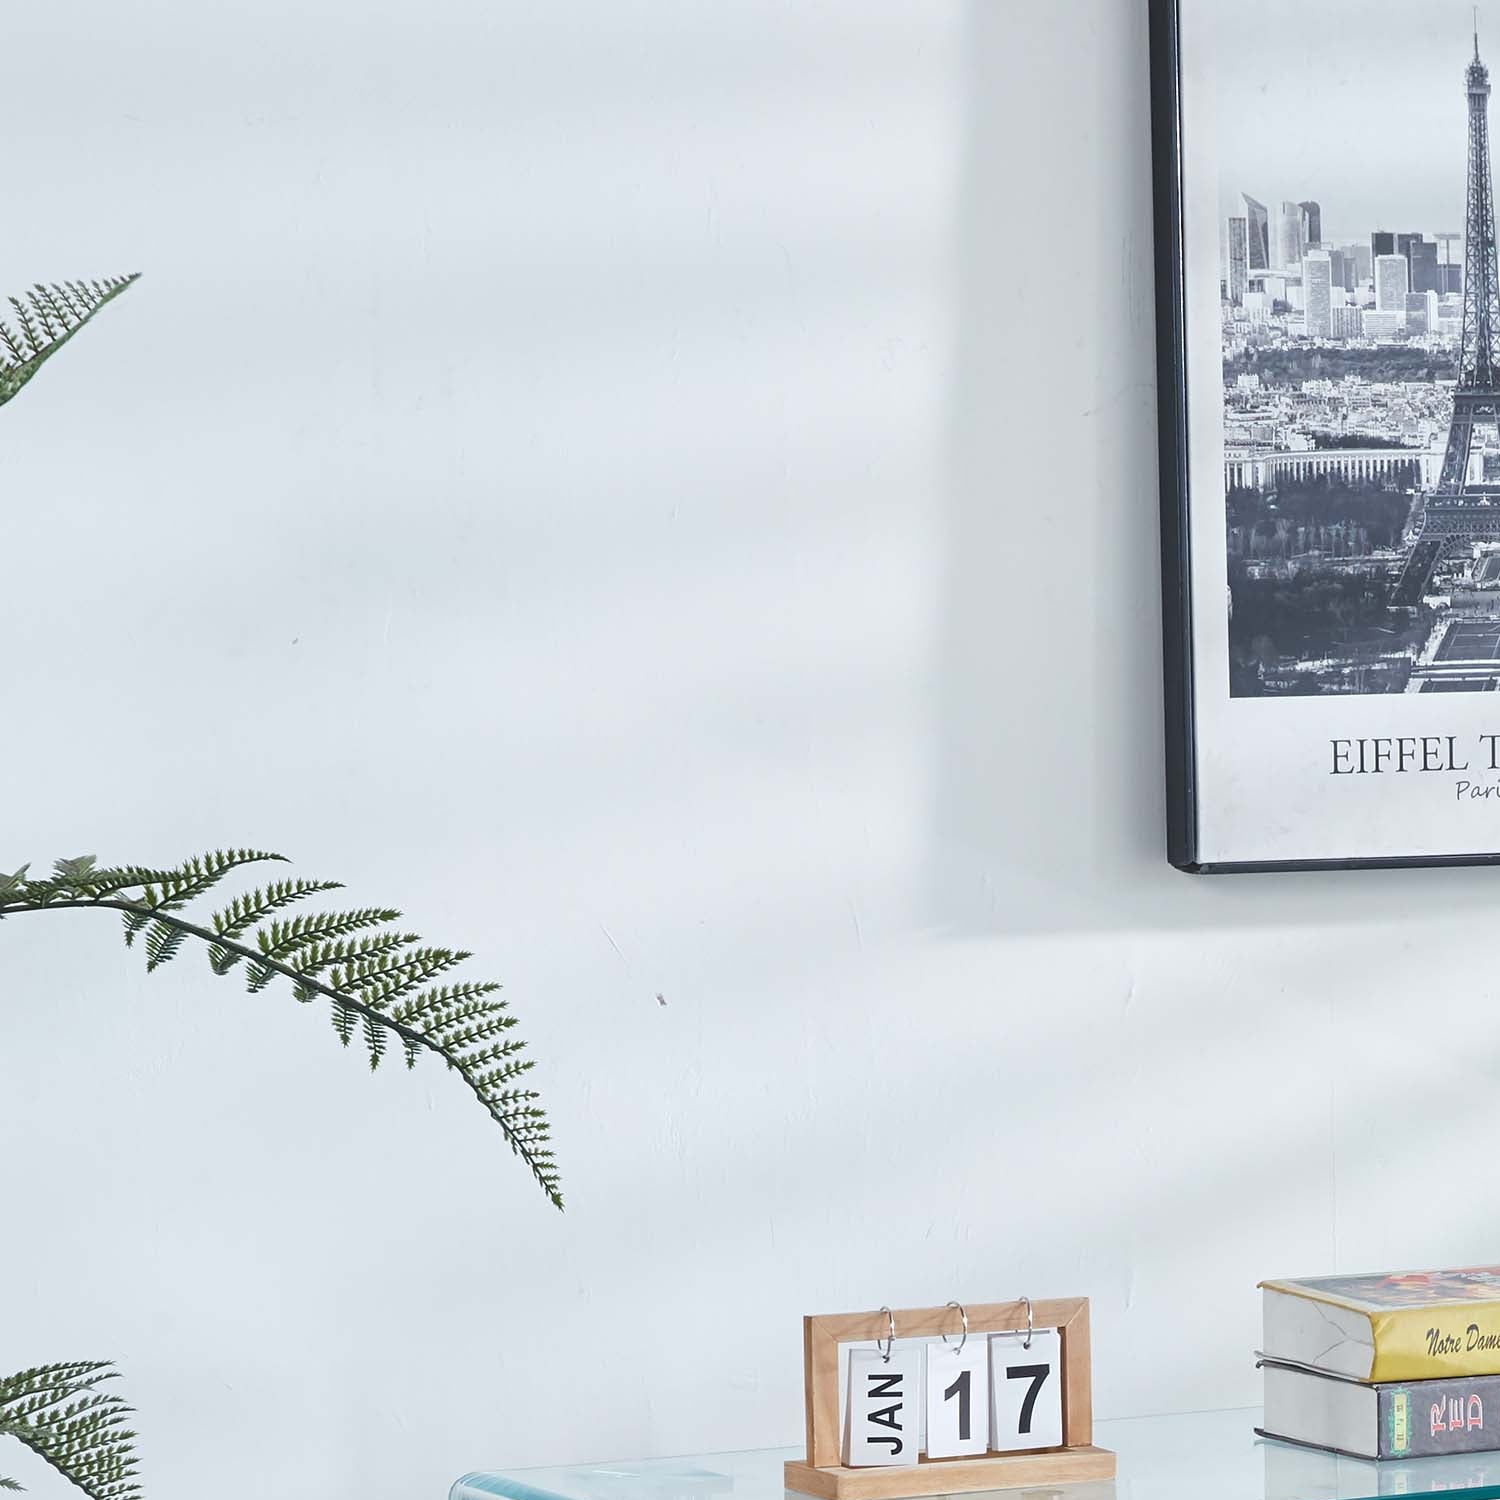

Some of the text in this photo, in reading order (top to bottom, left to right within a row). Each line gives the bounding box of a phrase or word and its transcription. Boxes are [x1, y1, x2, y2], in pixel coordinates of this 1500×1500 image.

[1329, 735, 1469, 775] EIFFEL
[1425, 1327, 1462, 1357] Notre
[866, 1373, 904, 1456] JAN
[1430, 1393, 1484, 1437] RED
